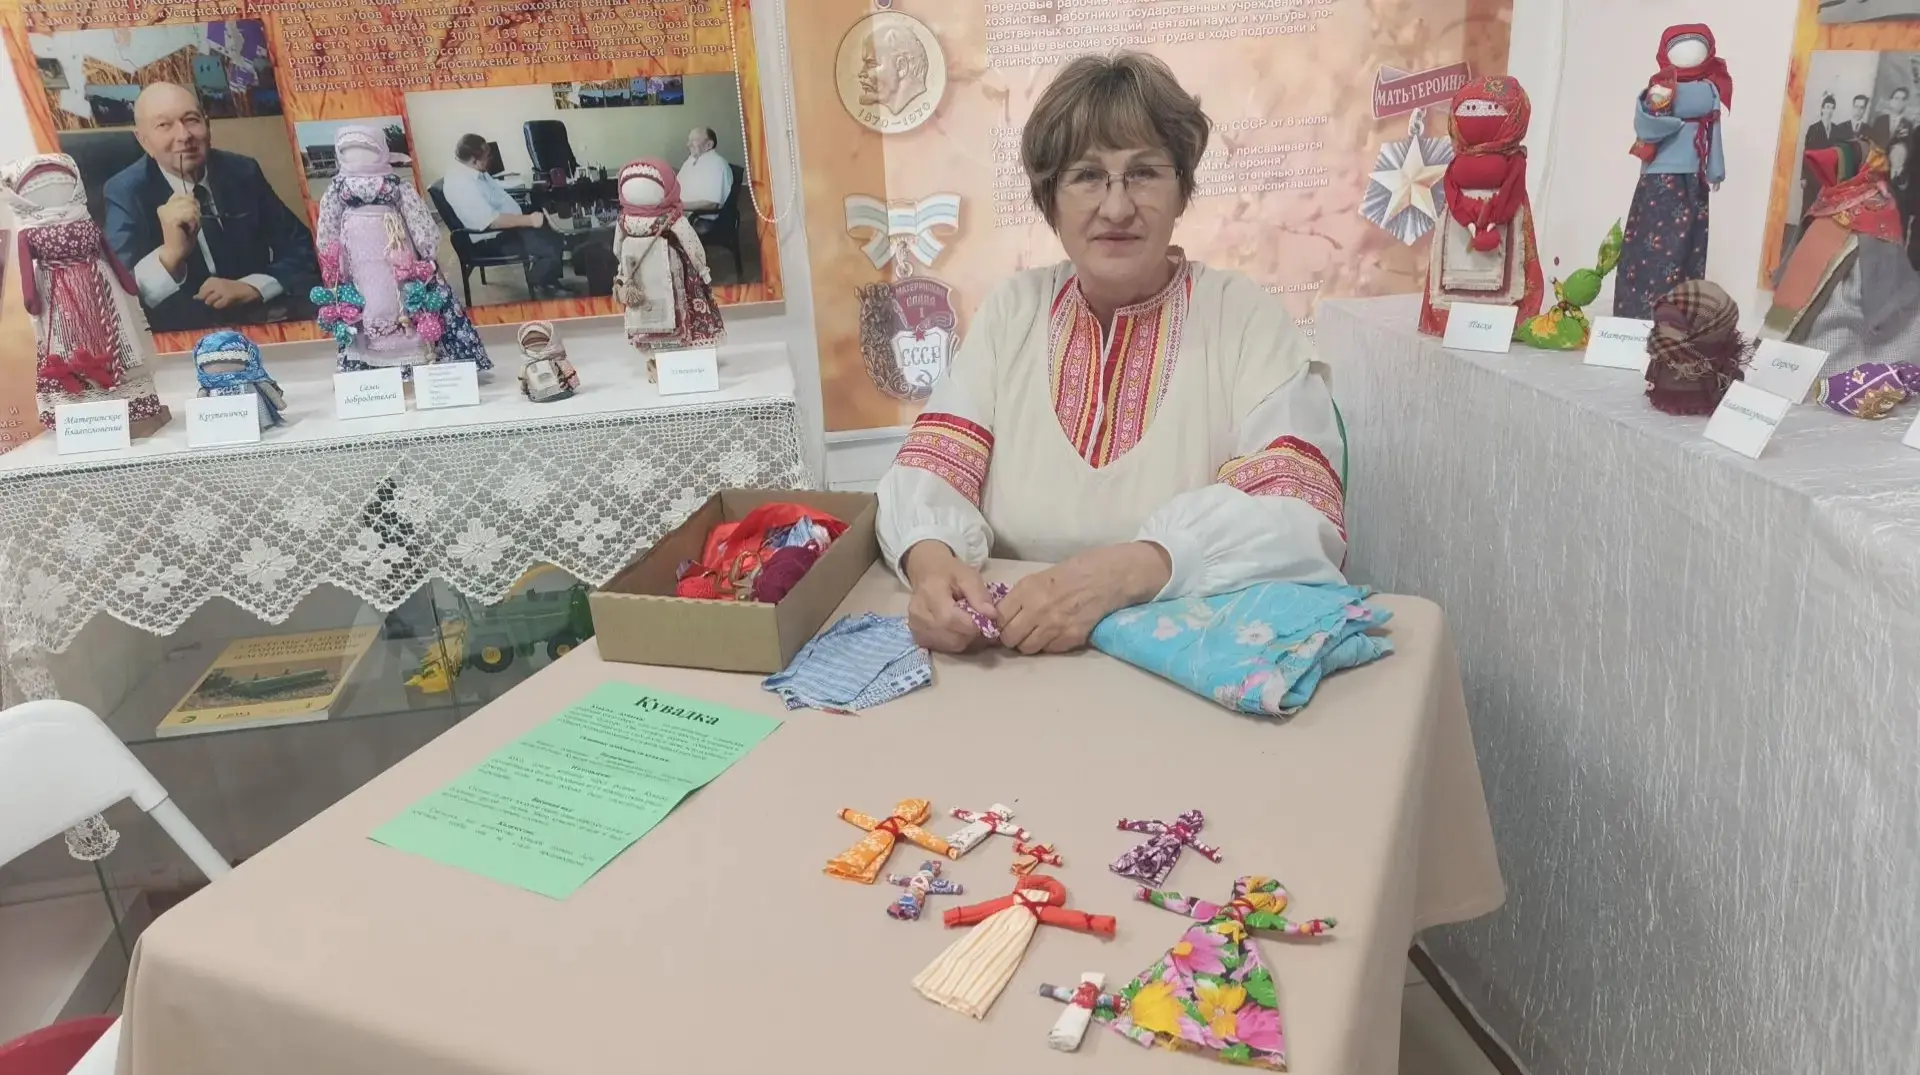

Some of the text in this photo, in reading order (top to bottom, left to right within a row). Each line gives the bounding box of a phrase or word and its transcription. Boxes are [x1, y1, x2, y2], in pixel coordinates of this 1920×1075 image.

[158, 4, 239, 18] «Успенский
[279, 14, 301, 25] тав
[306, 12, 328, 24] 3-х
[335, 9, 383, 23] клубов
[391, 5, 476, 21] крупнейших
[479, 0, 629, 13] сельскохозяйственных
[984, 0, 1053, 13] передовые
[984, 14, 1051, 27] хозяйства,
[1055, 11, 1118, 24] работники
[1122, 4, 1226, 19] государственных
[315, 26, 349, 37] клуб
[354, 21, 427, 35] «Сахарная
[431, 19, 476, 29] свекла
[482, 15, 511, 27] 100»
[525, 13, 533, 24] 3
[585, 8, 616, 22] клуб
[622, 8, 666, 21] «Зерно
[683, 4, 711, 15] 100»
[985, 9, 1333, 41] щественных организаций, деятели науки и культуры, по-
[284, 41, 300, 52] 74
[355, 37, 388, 49] клуб
[393, 34, 433, 47] «Агро
[450, 31, 480, 43] 300»
[495, 29, 518, 39] 133
[570, 24, 587, 35] На
[592, 22, 642, 36] форуме
[647, 19, 689, 31] Союза
[693, 17, 727, 28] саха-
[985, 23, 1316, 55] казавшие высокие образцы труда в ходе подготовки к
[288, 33, 689, 68] ропроизводителей России в 2010 году предприятию вручен
[986, 53, 1060, 68] ленинскому
[293, 67, 346, 81] Диплом
[365, 62, 419, 74] степени
[423, 63, 436, 71] за
[440, 58, 519, 71] достижение
[523, 53, 580, 66] высоких
[585, 48, 665, 61] показателей
[673, 46, 697, 56] при
[702, 44, 730, 55] про-
[295, 72, 489, 93] изводстве сахарной свеклы.
[1231, 119, 1267, 131] СССР
[1271, 118, 1284, 128] от
[1287, 116, 1295, 127] 8
[1298, 114, 1328, 126] июля
[1202, 147, 1233, 160] етей,
[1236, 140, 1323, 156] присваивается
[1195, 171, 1235, 185] ысшей
[1238, 169, 1294, 182] степенью
[1297, 166, 1328, 176] отли-
[1240, 184, 1248, 193] и
[1251, 178, 1329, 192] воспитавшим
[901, 345, 941, 367] СССР
[633, 696, 720, 727] Кувадка
